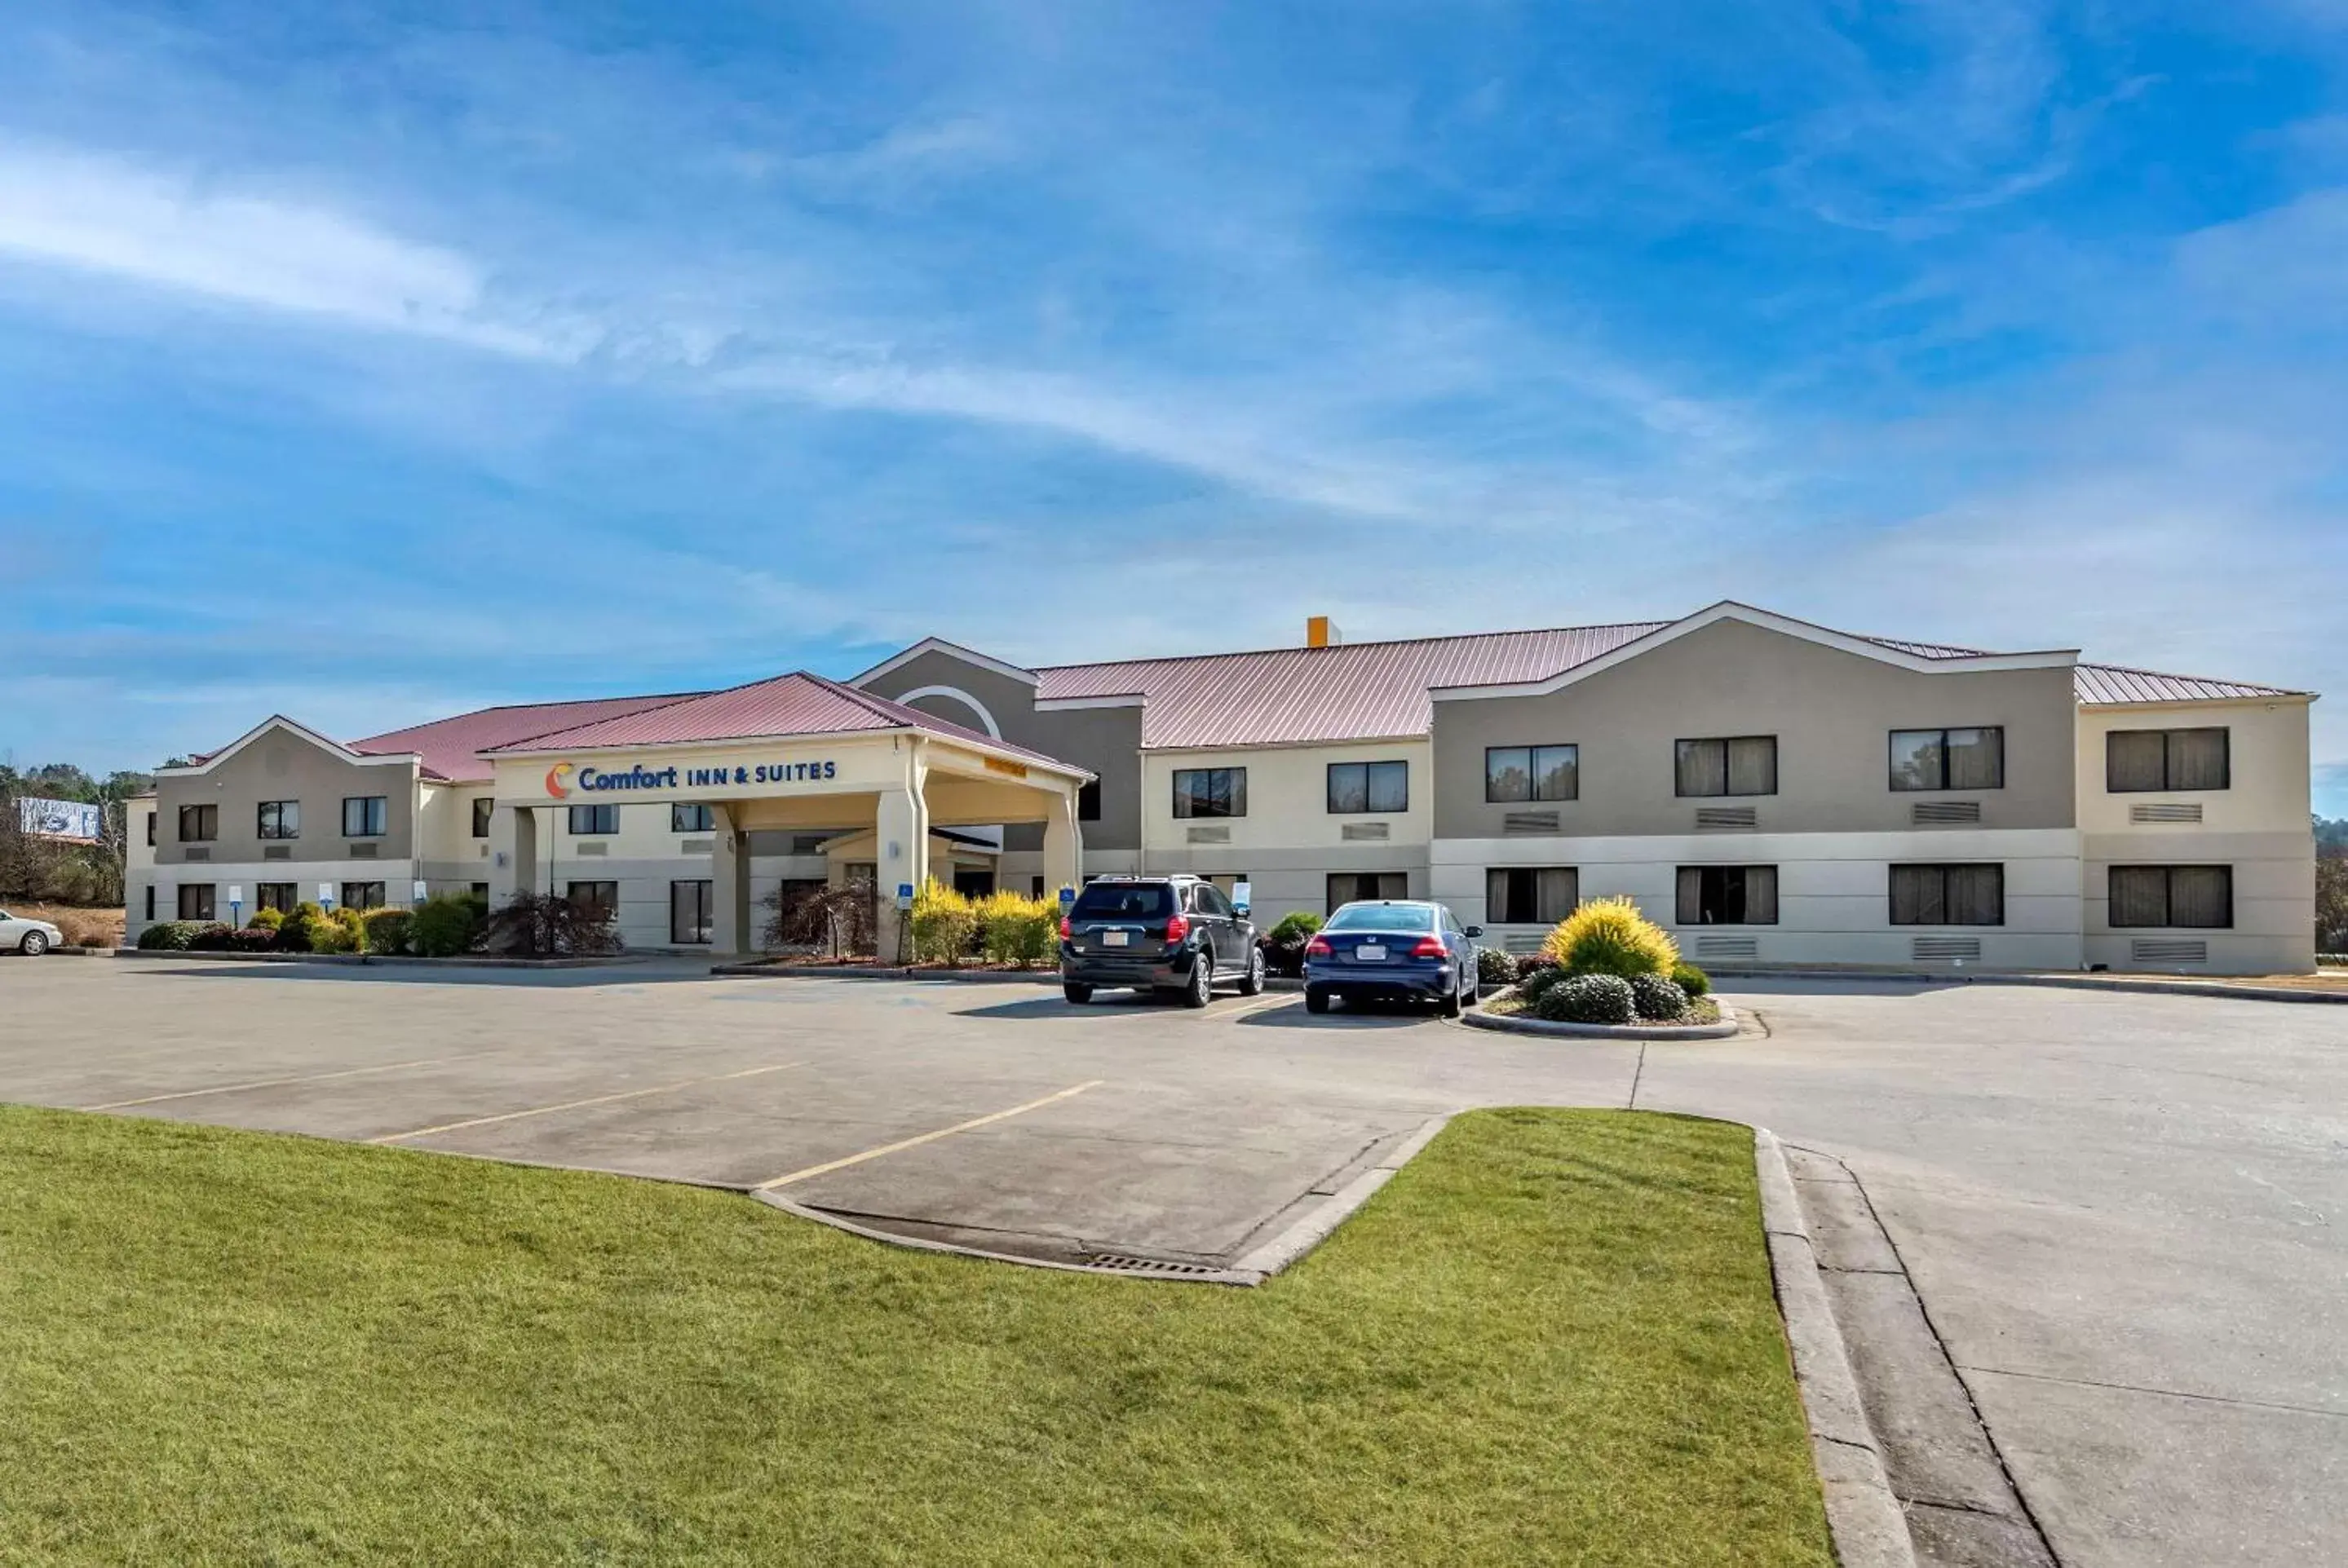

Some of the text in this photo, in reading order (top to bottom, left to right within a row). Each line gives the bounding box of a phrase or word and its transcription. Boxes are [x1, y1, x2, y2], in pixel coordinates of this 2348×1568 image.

[578, 761, 836, 792] Comfort INN & SUITES
